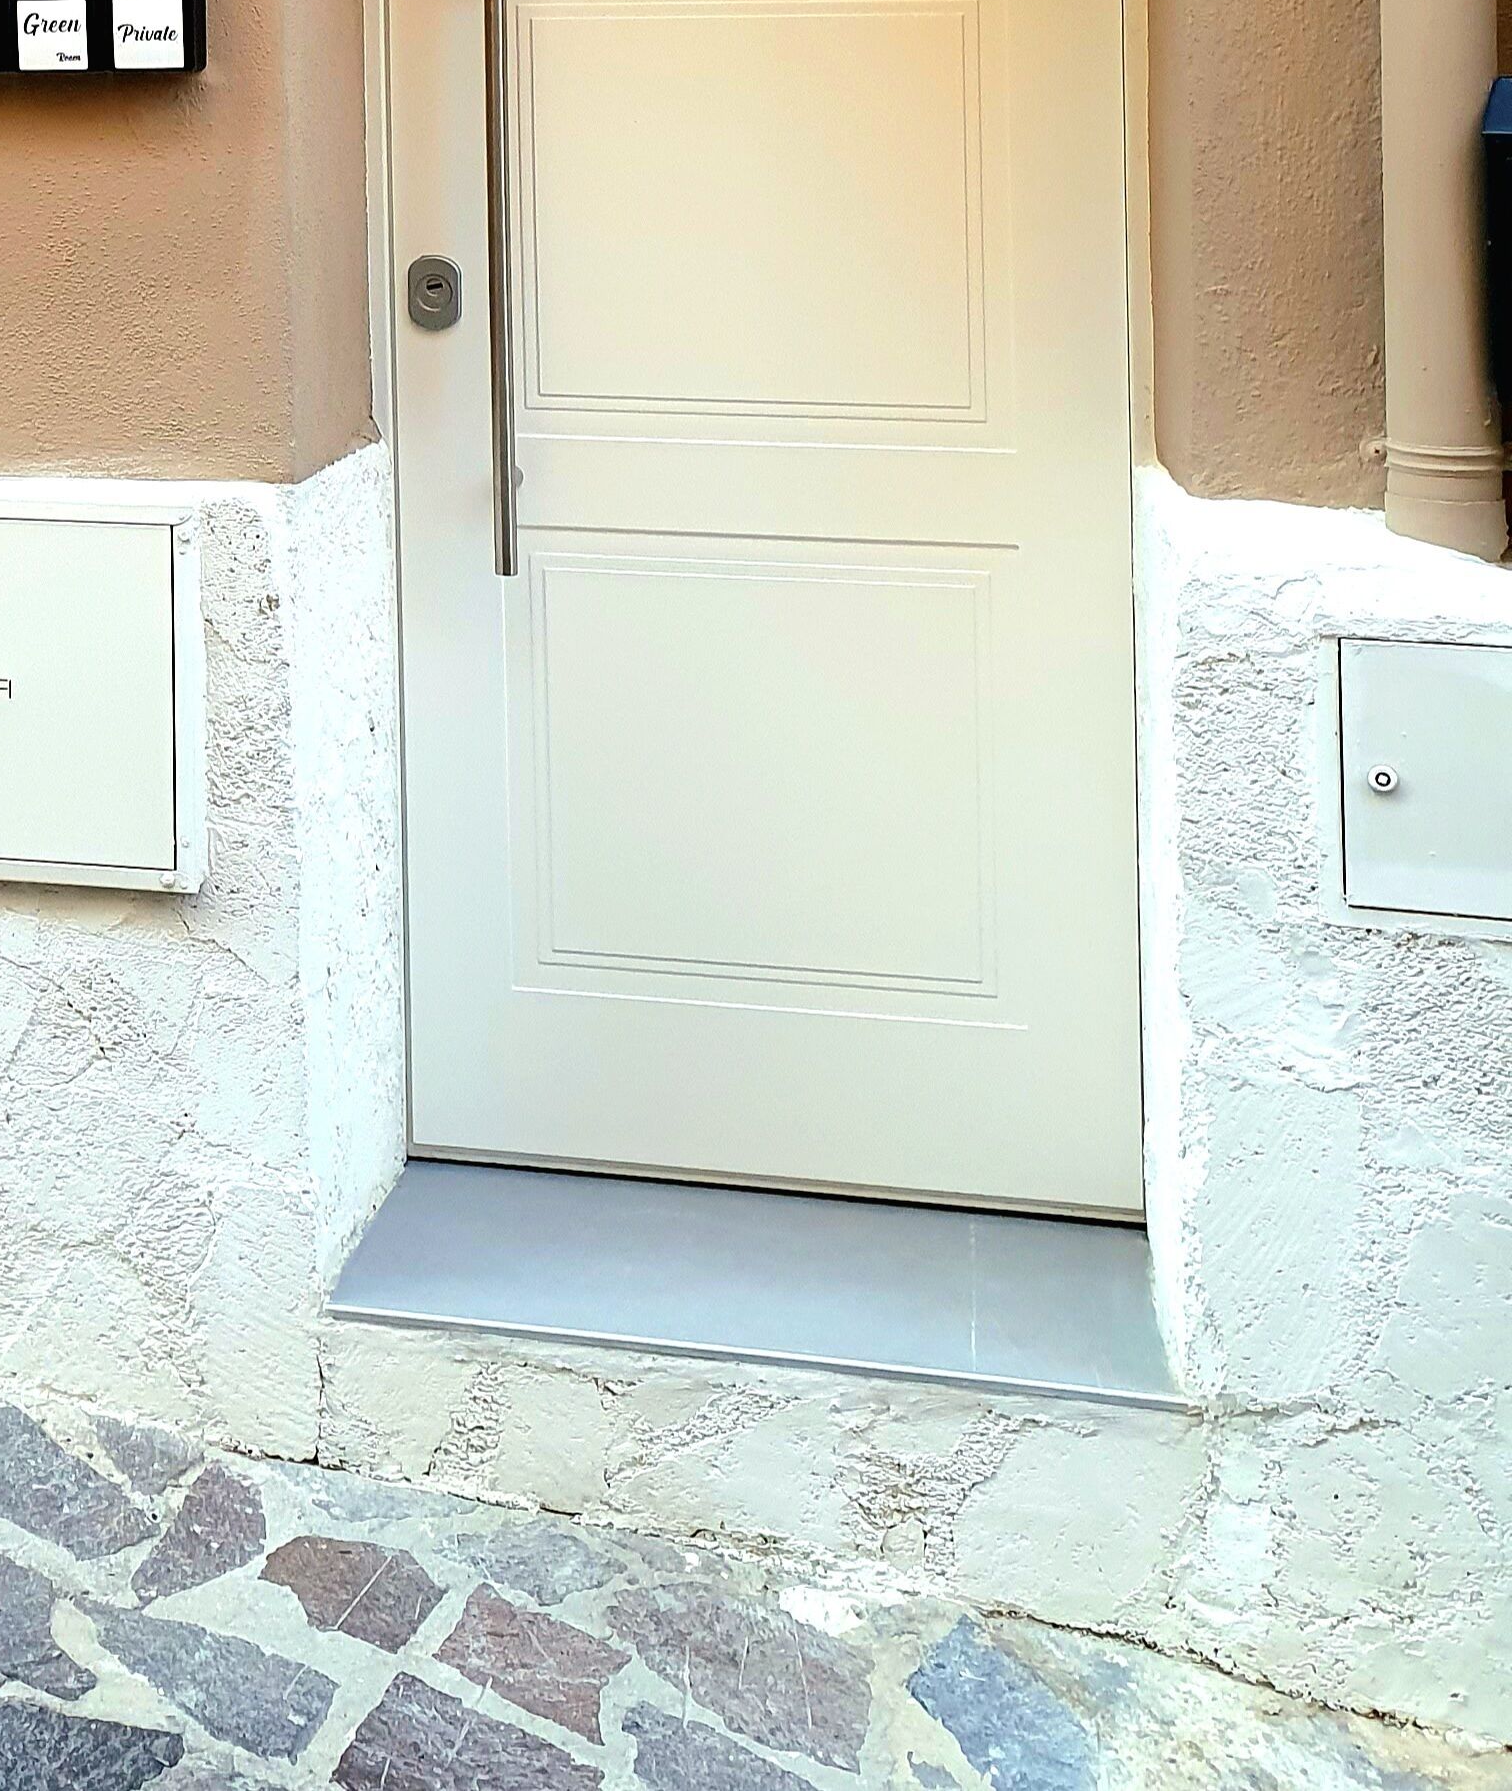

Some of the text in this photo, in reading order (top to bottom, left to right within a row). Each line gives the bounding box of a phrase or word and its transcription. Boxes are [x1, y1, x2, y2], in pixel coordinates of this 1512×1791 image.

[23, 12, 81, 37] Green
[117, 24, 178, 43] Private
[56, 52, 81, 62] Room
